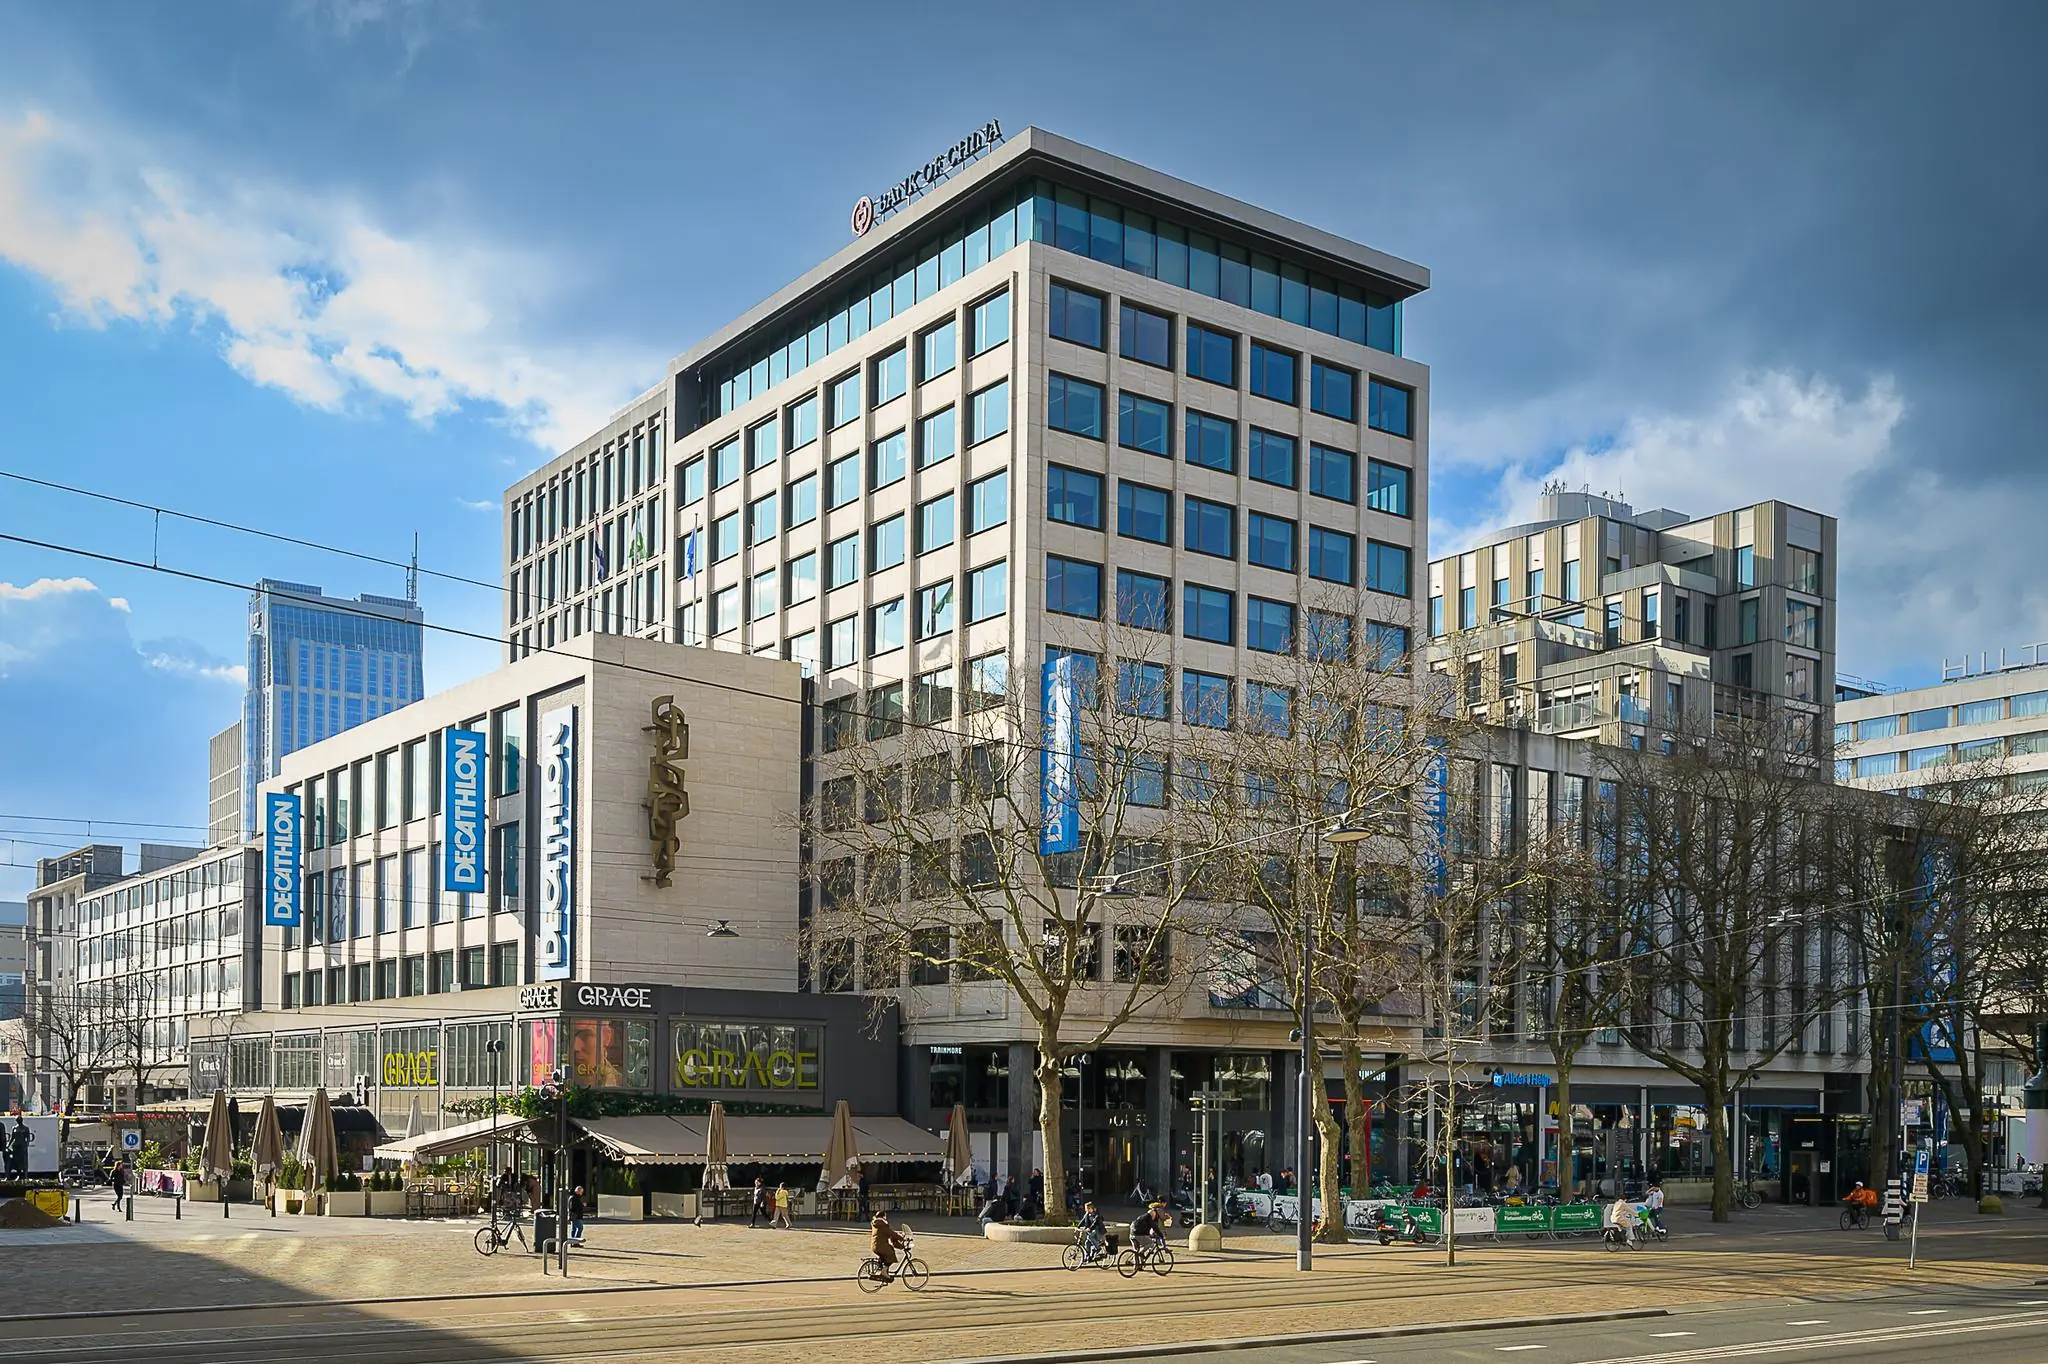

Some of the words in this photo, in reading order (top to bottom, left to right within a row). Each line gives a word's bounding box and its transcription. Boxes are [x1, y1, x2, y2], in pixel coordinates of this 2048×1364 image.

[879, 171, 922, 211] BANK
[923, 154, 945, 183] OF
[948, 119, 1003, 166] CHINA
[453, 739, 477, 883] DECATHLON
[273, 801, 293, 919] DECATHLON
[545, 722, 569, 968] DECATHLON
[519, 986, 552, 1008] GRACE
[578, 985, 652, 1008] GRACE
[930, 1046, 962, 1054] TRAINMORE
[384, 1051, 437, 1085] GRACE
[679, 1048, 817, 1087] GRACE
[1504, 1072, 1530, 1085] Albert
[1531, 1072, 1552, 1088] Heijn
[1920, 1153, 1927, 1165] P
